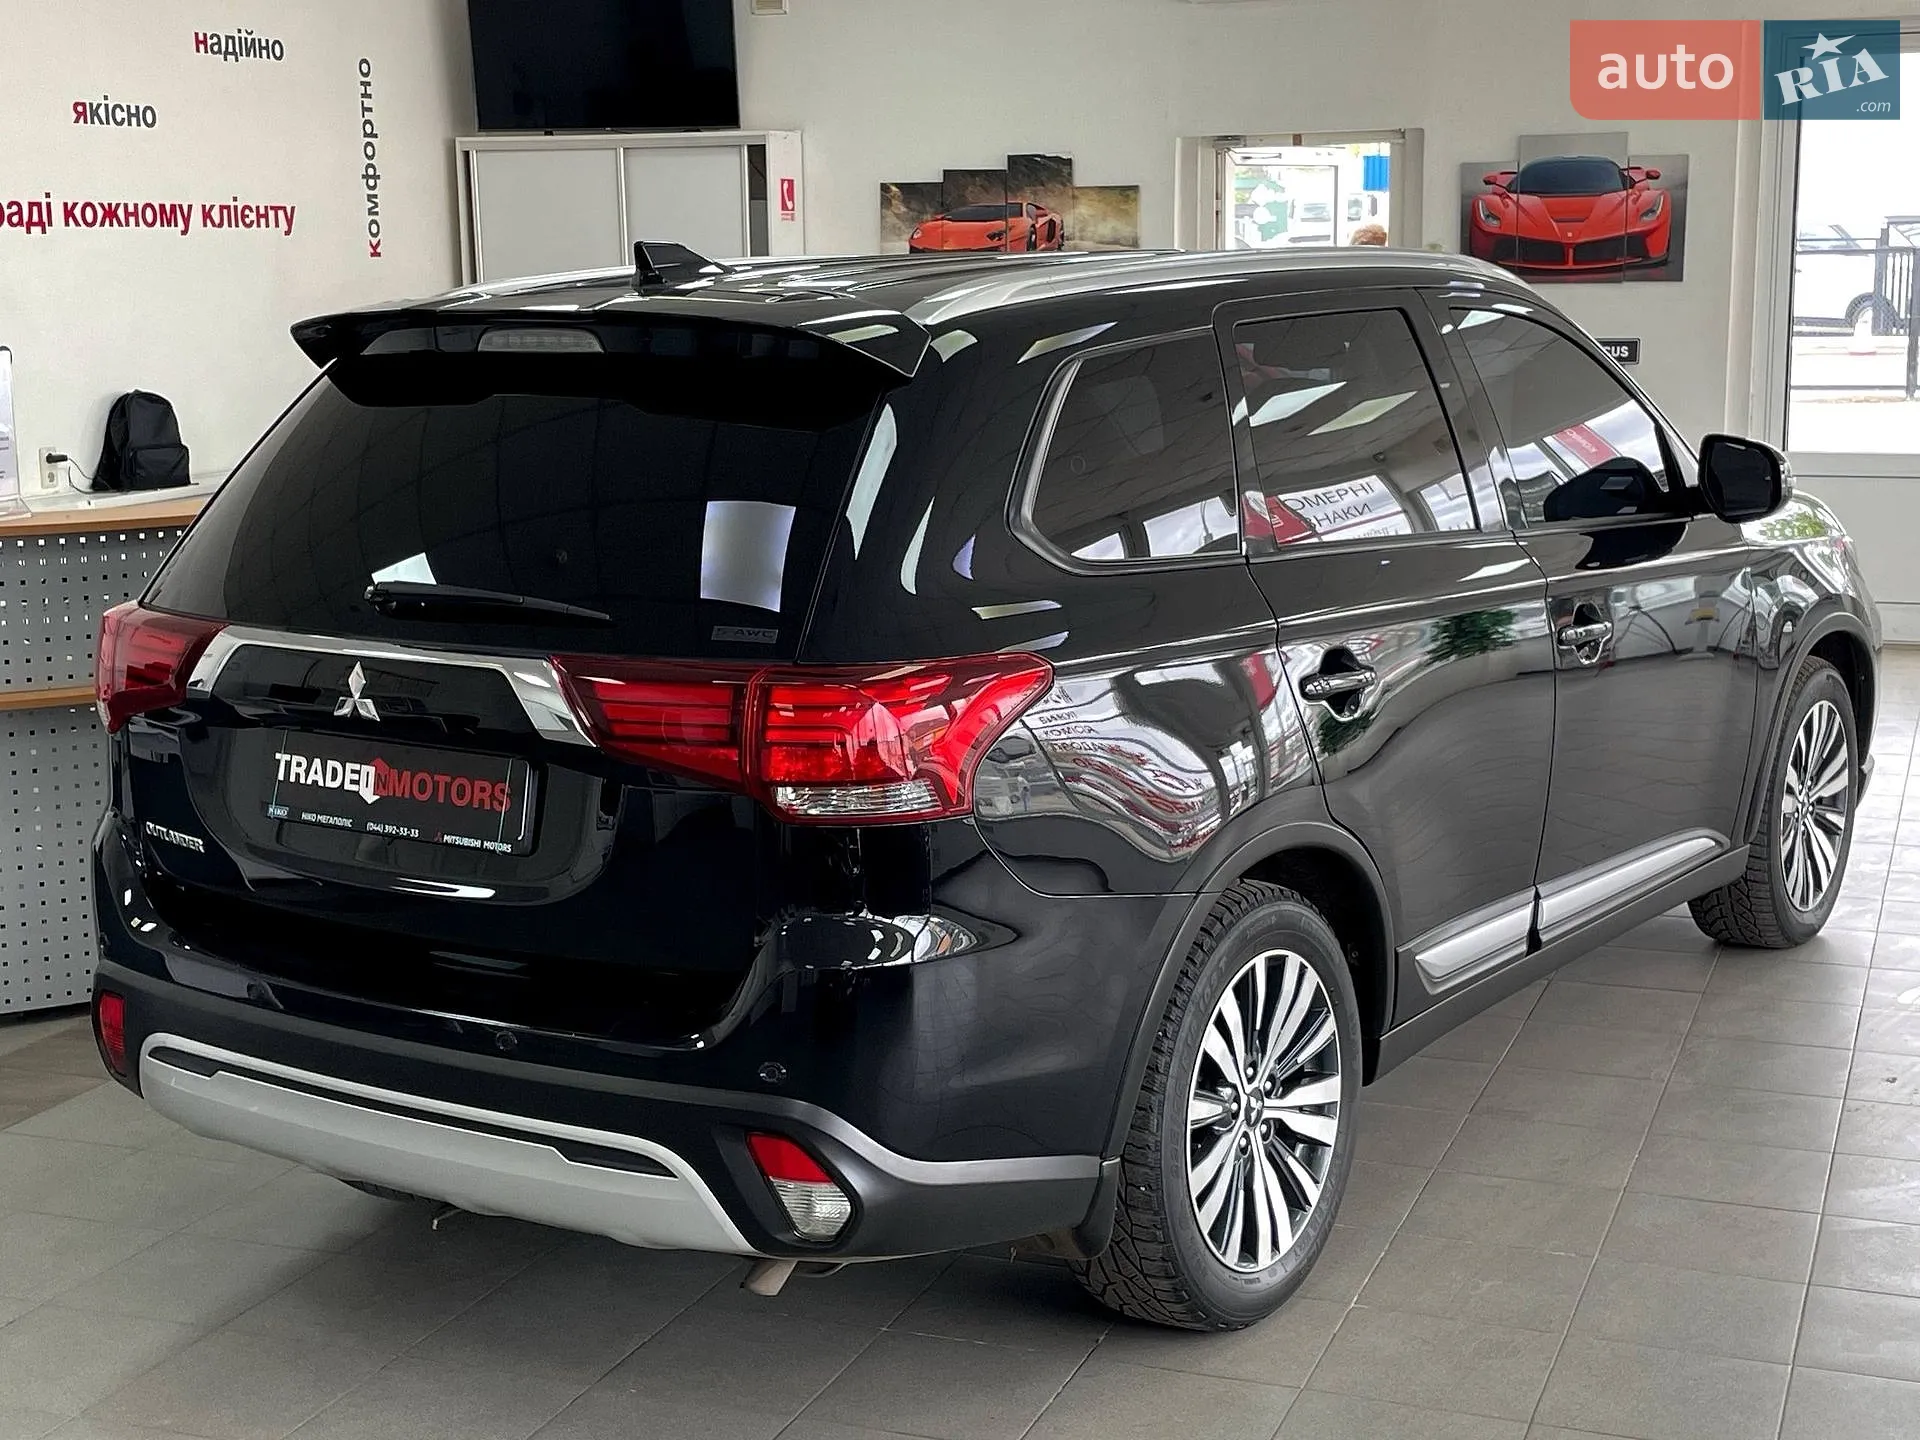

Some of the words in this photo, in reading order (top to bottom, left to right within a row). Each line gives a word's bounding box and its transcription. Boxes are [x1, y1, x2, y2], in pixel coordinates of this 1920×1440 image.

[194, 28, 285, 63] надійно
[72, 95, 157, 128] якісно
[358, 58, 382, 258] комфортно
[63, 199, 192, 236] кожному
[202, 197, 296, 236] клієнту
[145, 821, 206, 854] OUTLANDER
[384, 824, 420, 838] 392-33-33
[443, 834, 482, 849] MITSUBISHI
[483, 841, 512, 853] MOTORS
